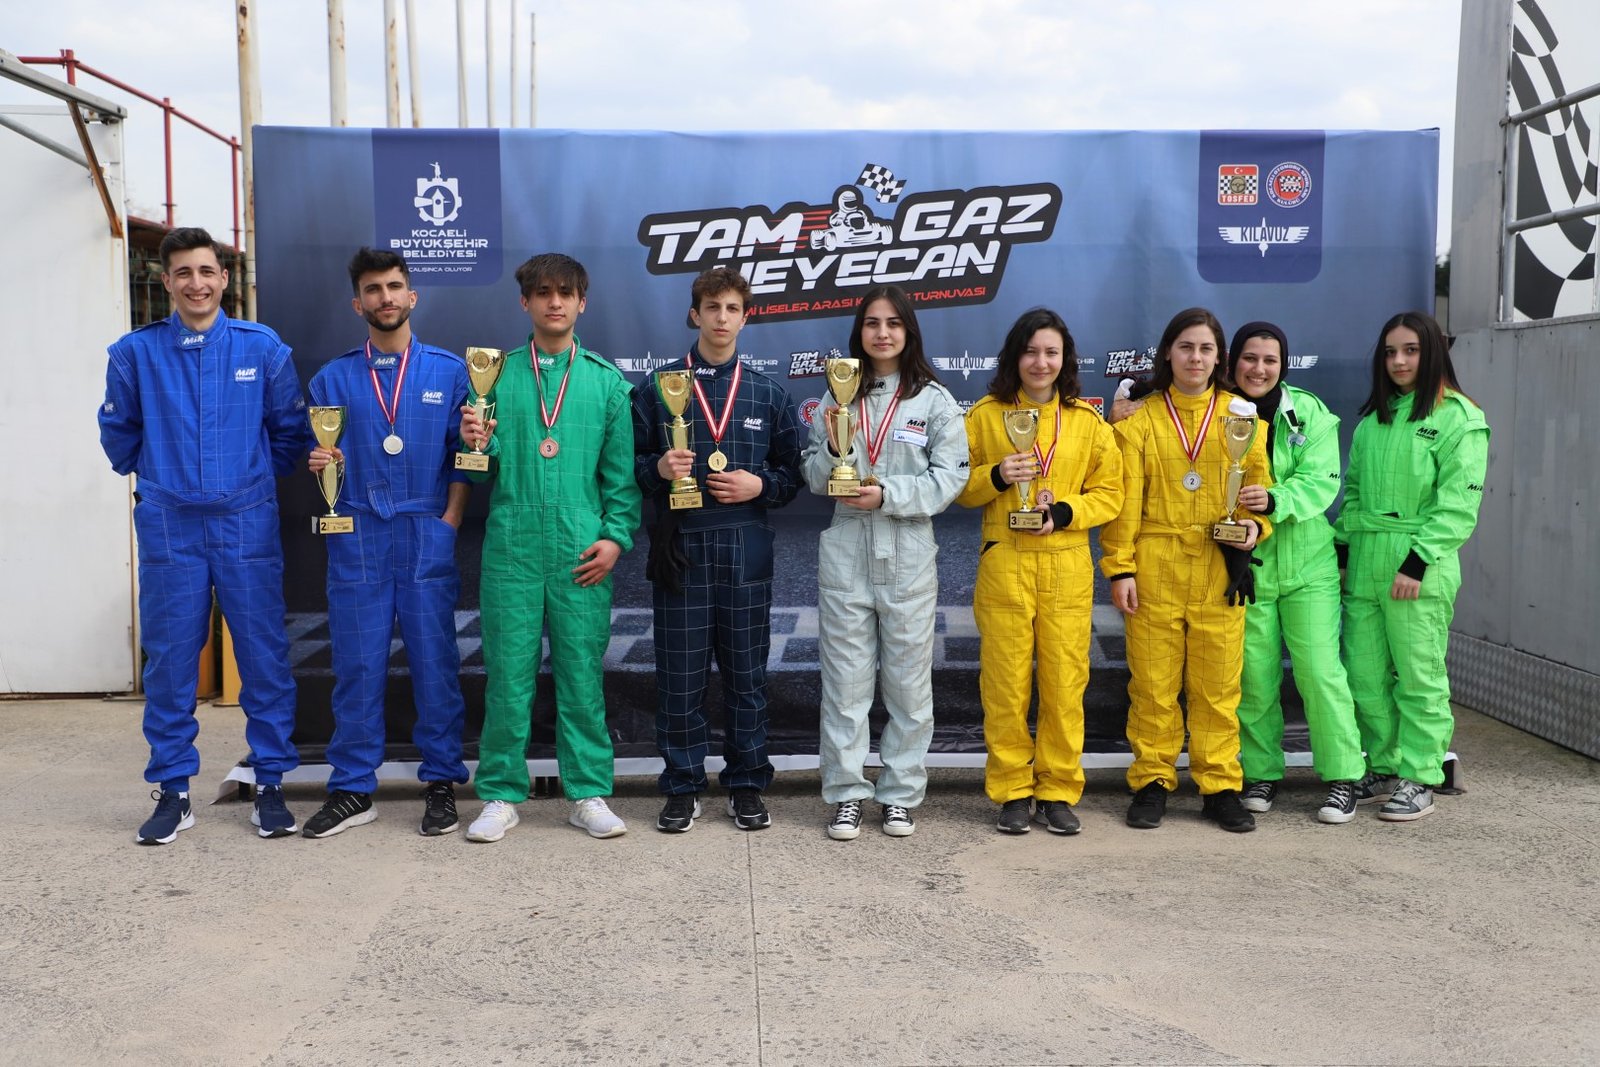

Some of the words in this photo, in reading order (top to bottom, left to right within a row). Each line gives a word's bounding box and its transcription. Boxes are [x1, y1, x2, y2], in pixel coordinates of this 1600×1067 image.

[1222, 195, 1255, 203] TOSFED
[411, 229, 467, 238] KOCAELİ
[649, 212, 804, 265] TAM
[900, 193, 1052, 242] GAZ
[1241, 226, 1289, 242] KILAVUZ
[390, 238, 489, 250] BÜYÜKŞEHİR
[403, 249, 477, 258] BELEDİYESİ
[760, 302, 809, 316] LİSELER
[811, 298, 853, 310] ARASI
[913, 286, 986, 302] TURNUVASI
[791, 351, 819, 362] TAM
[1107, 350, 1136, 360] TAM
[791, 360, 817, 369] GAZ
[948, 357, 986, 369] KILAVUZ
[1107, 358, 1135, 368] GAZ
[789, 366, 825, 376] HEYEC
[546, 445, 552, 453] 3
[456, 456, 462, 466] 3
[1189, 477, 1195, 486] 2
[1043, 494, 1048, 502] 3
[1011, 516, 1017, 525] 3
[321, 521, 327, 531] 2
[1214, 527, 1220, 537] 2
